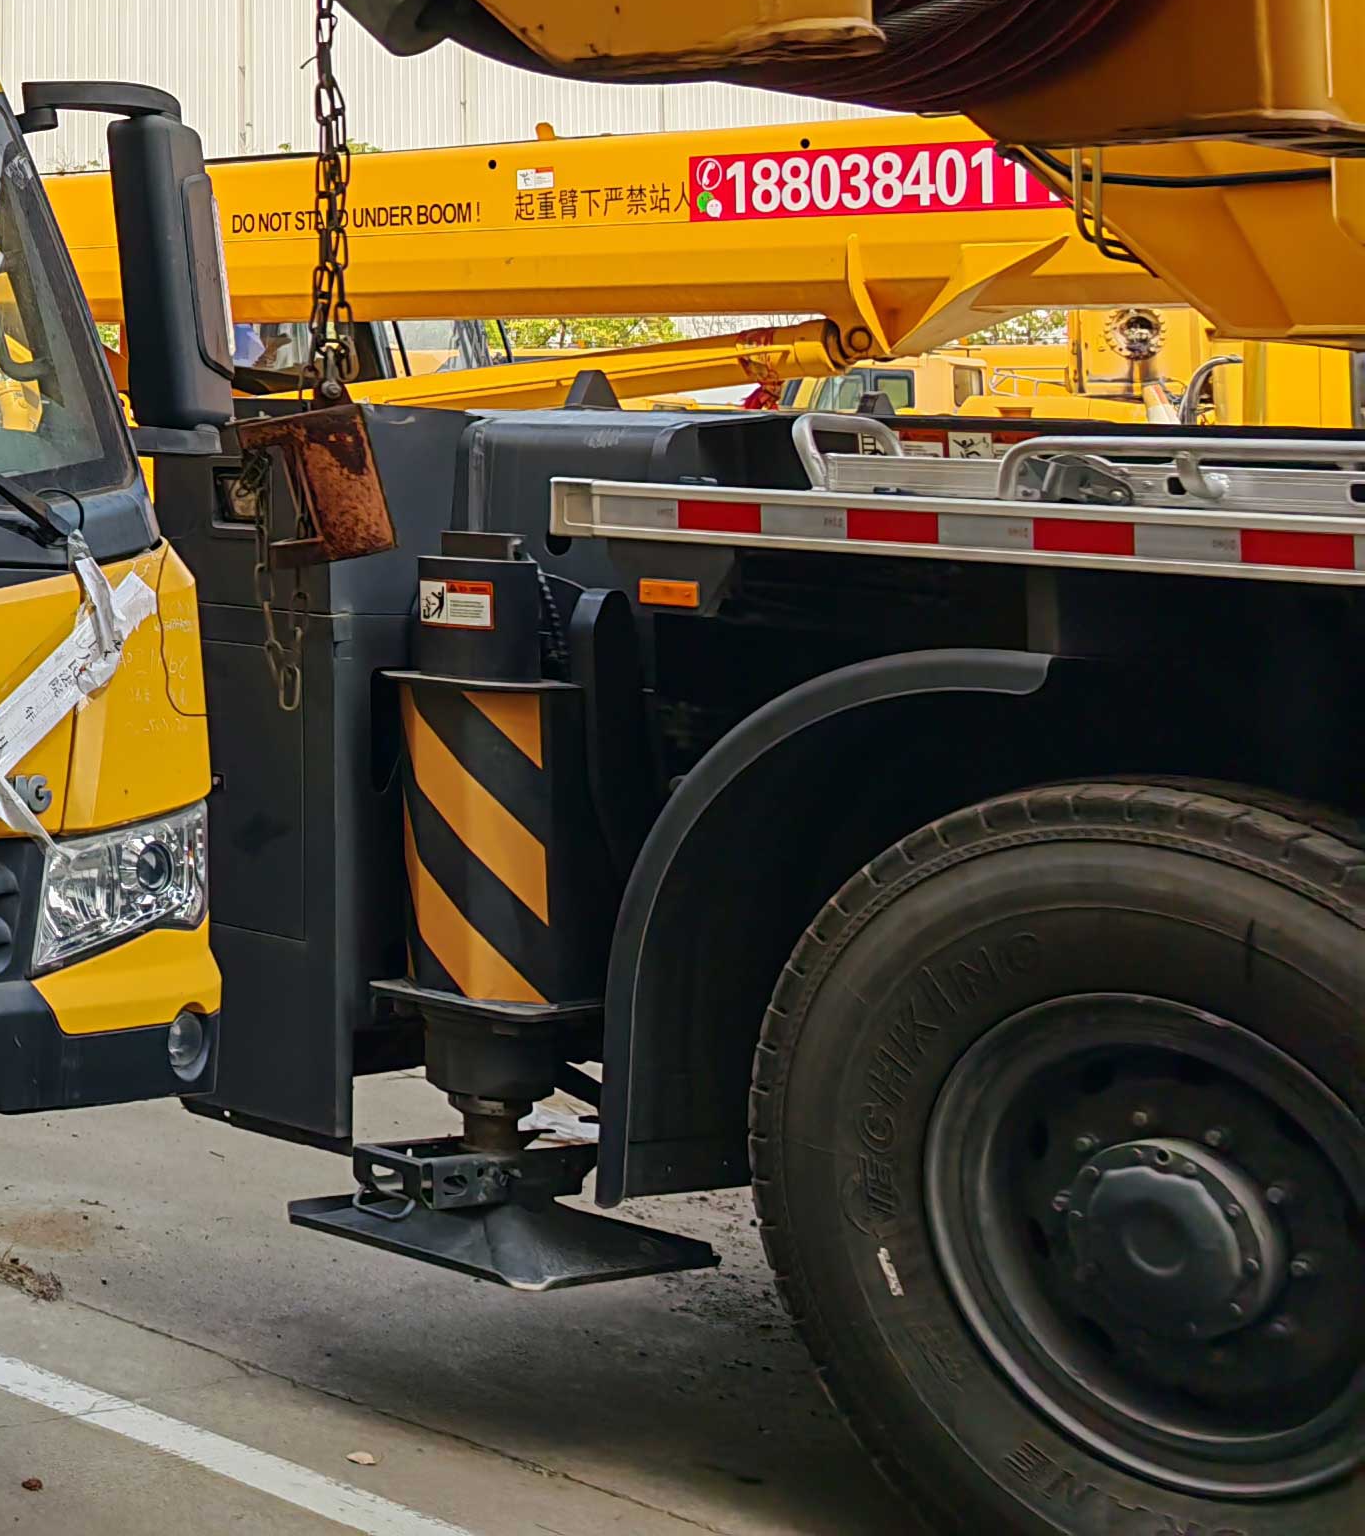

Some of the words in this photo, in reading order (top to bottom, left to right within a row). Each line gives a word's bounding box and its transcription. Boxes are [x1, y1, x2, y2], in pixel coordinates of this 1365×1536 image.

[725, 147, 1062, 214] 1880384011
[231, 214, 255, 234] DO
[258, 211, 292, 233] NOT
[294, 210, 349, 231] STAD
[352, 205, 414, 229] UNDER
[416, 202, 472, 226] BOOM
[513, 182, 691, 222] 起重臂下严禁站人
